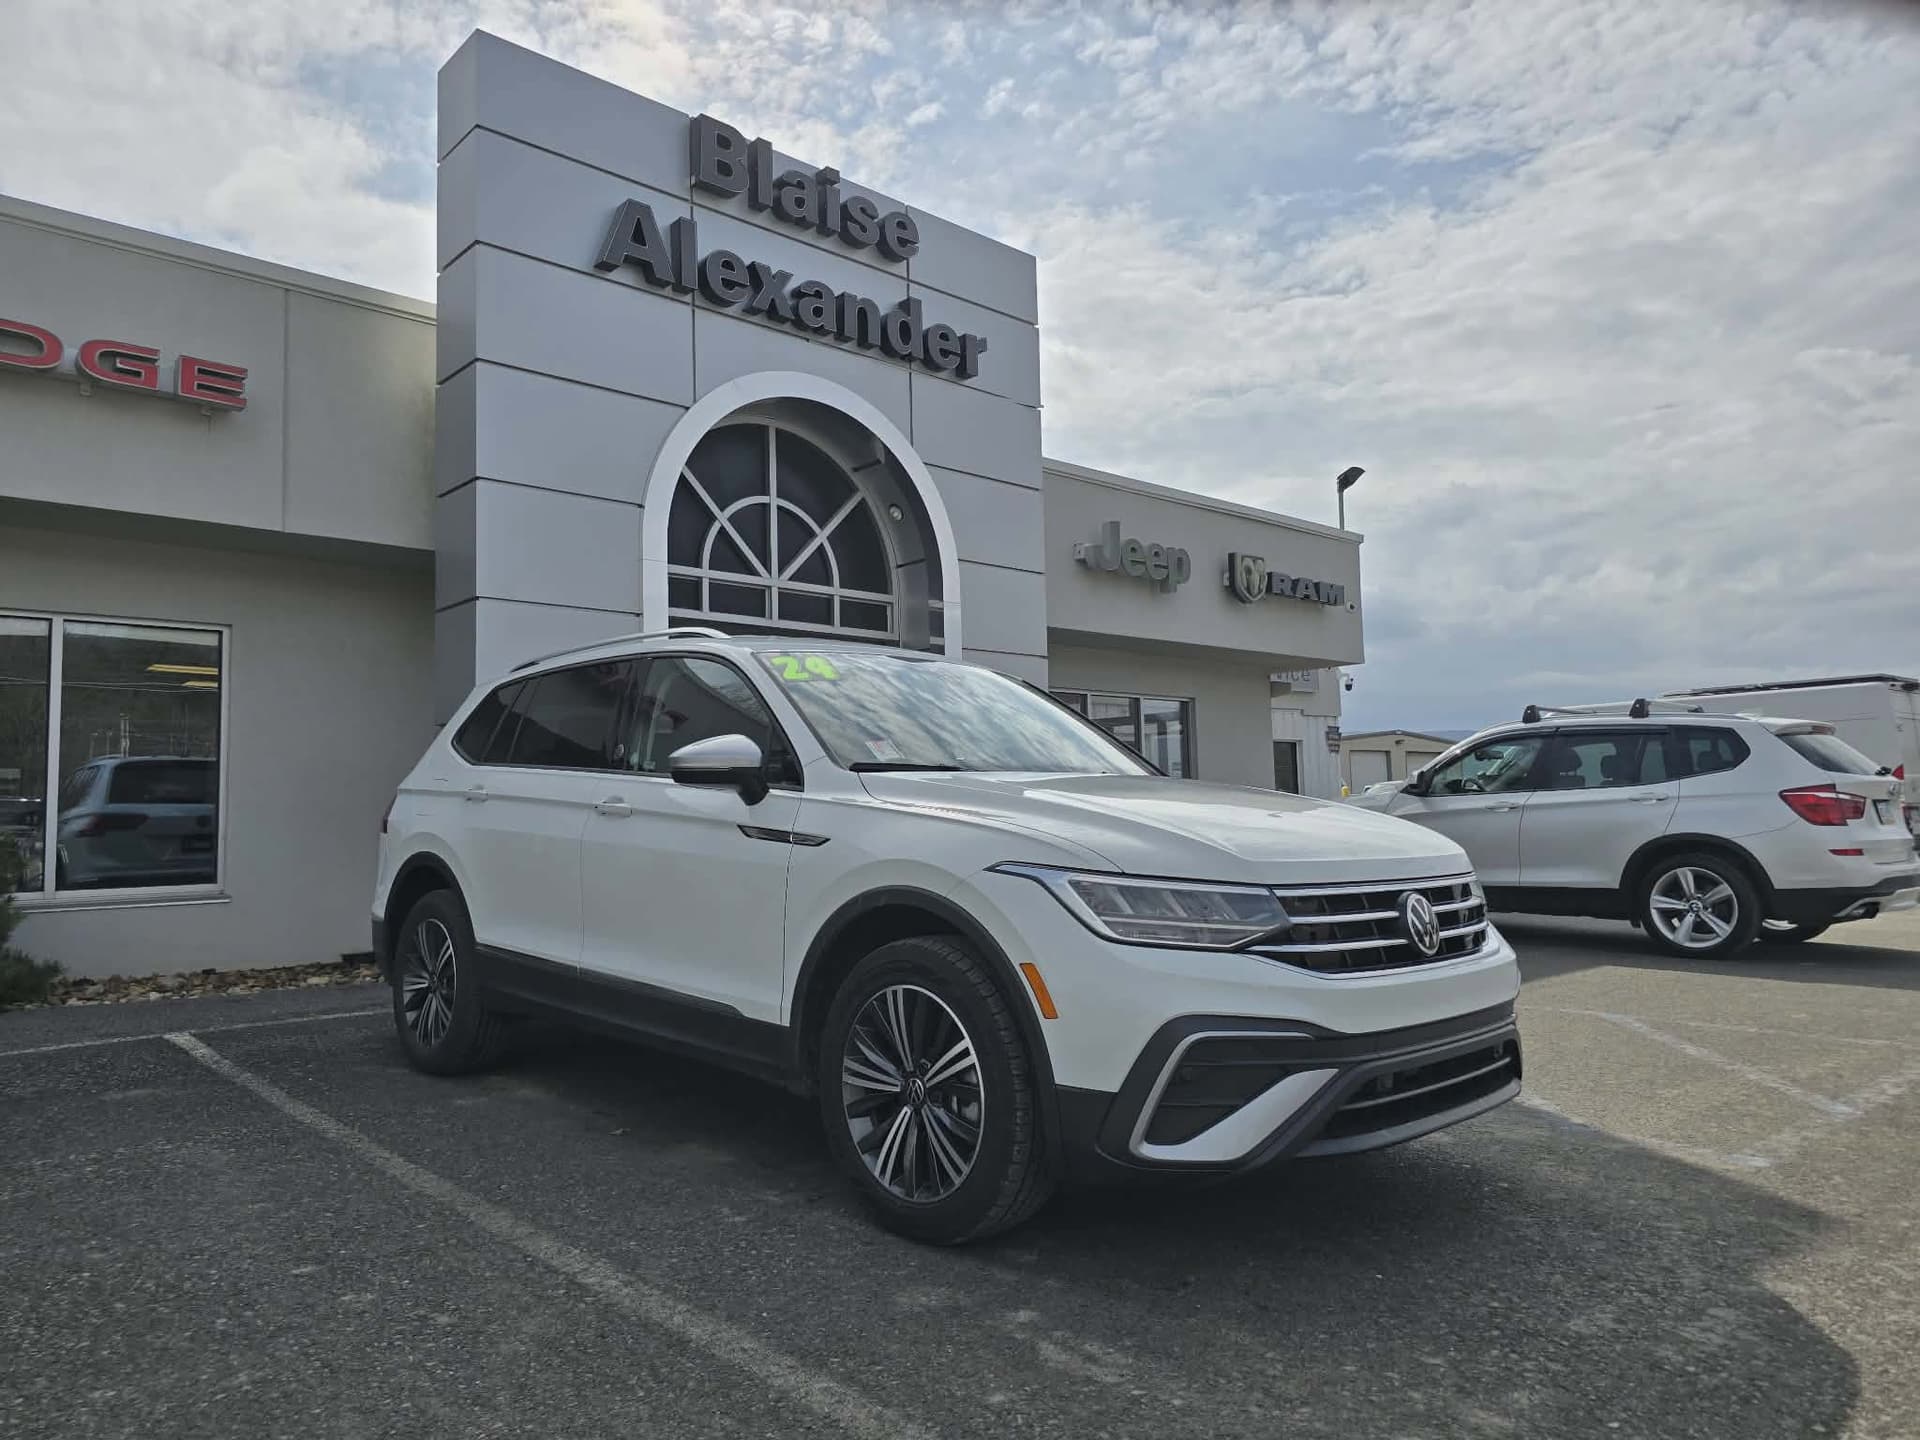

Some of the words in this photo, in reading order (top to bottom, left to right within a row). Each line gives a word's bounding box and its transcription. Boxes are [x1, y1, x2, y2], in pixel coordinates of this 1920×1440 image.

[690, 113, 920, 262] Blaise
[594, 199, 988, 379] Alexander
[1083, 521, 1191, 592] Jeep
[1266, 572, 1345, 606] RAM
